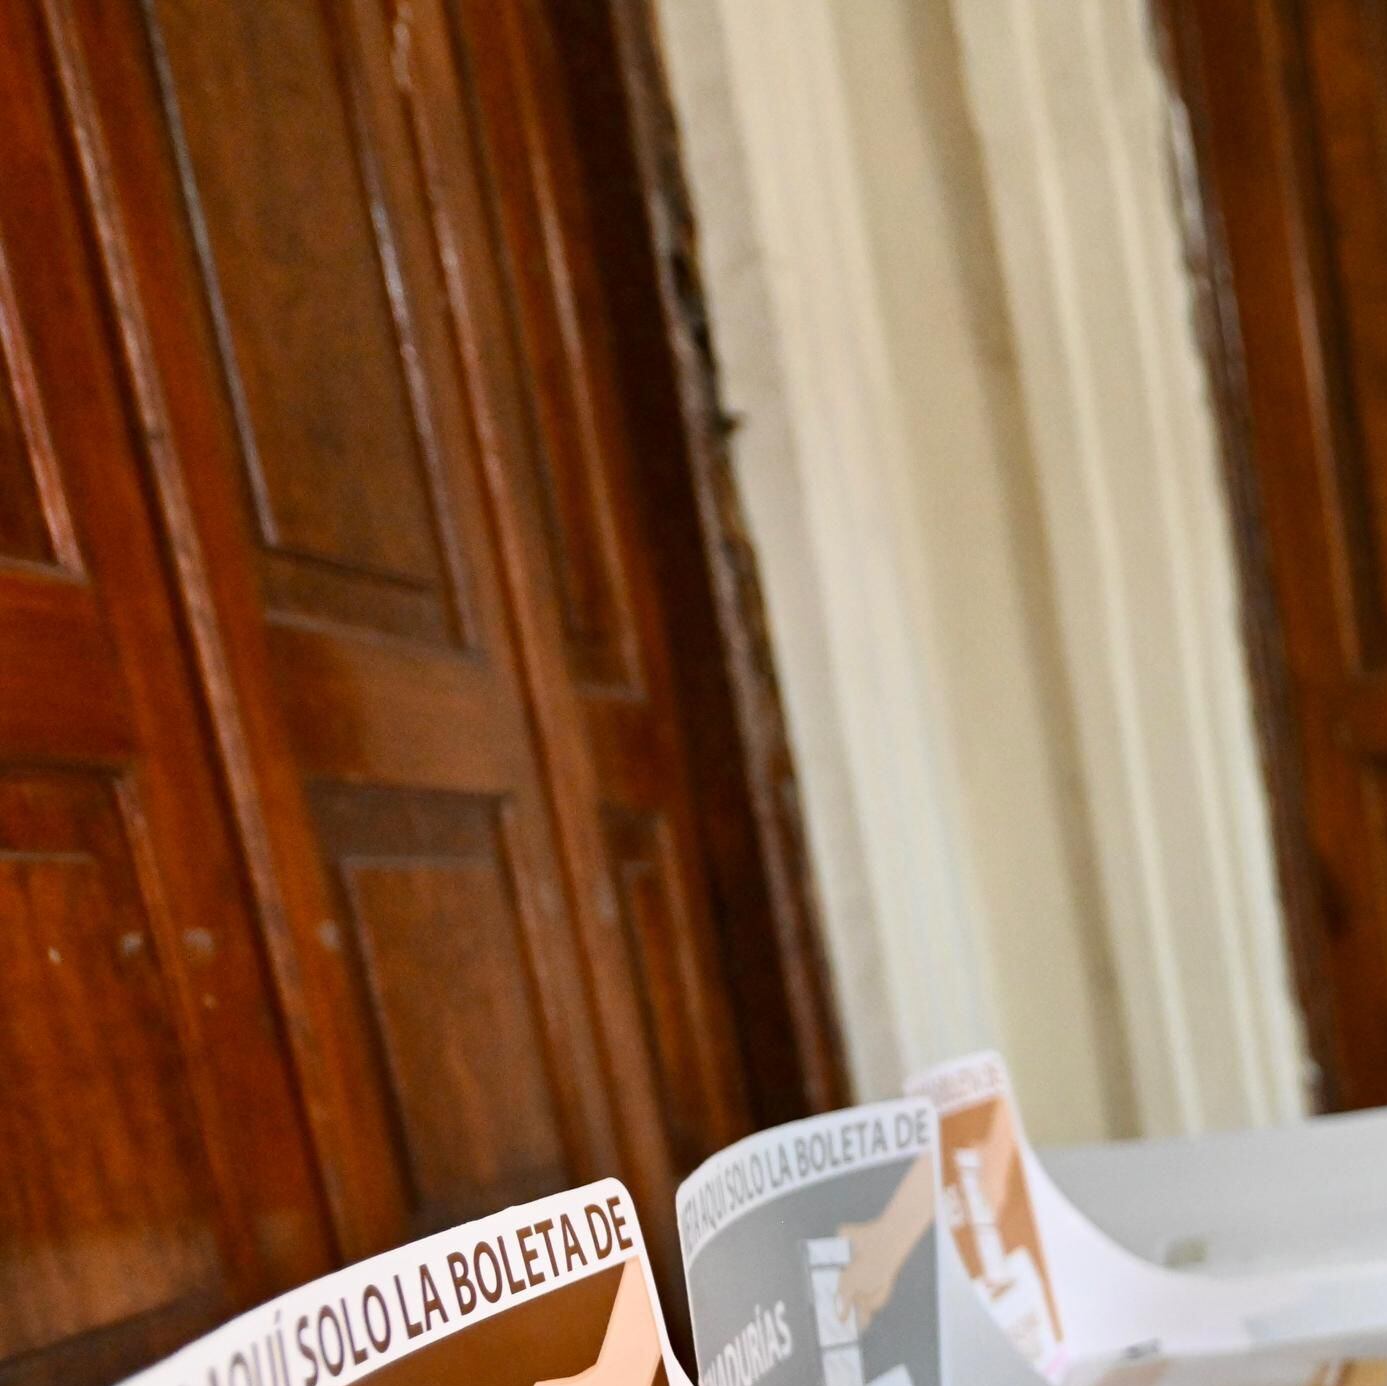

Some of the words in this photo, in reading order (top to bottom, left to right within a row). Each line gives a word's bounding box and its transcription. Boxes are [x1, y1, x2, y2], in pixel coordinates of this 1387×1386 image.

[724, 1151, 764, 1212] SOLO
[764, 1142, 793, 1188] LA
[793, 1116, 888, 1178] BOLETA
[895, 1109, 930, 1148] DE
[393, 1263, 450, 1341] LA
[449, 1212, 589, 1318] BOLETA
[583, 1195, 634, 1261] DE
